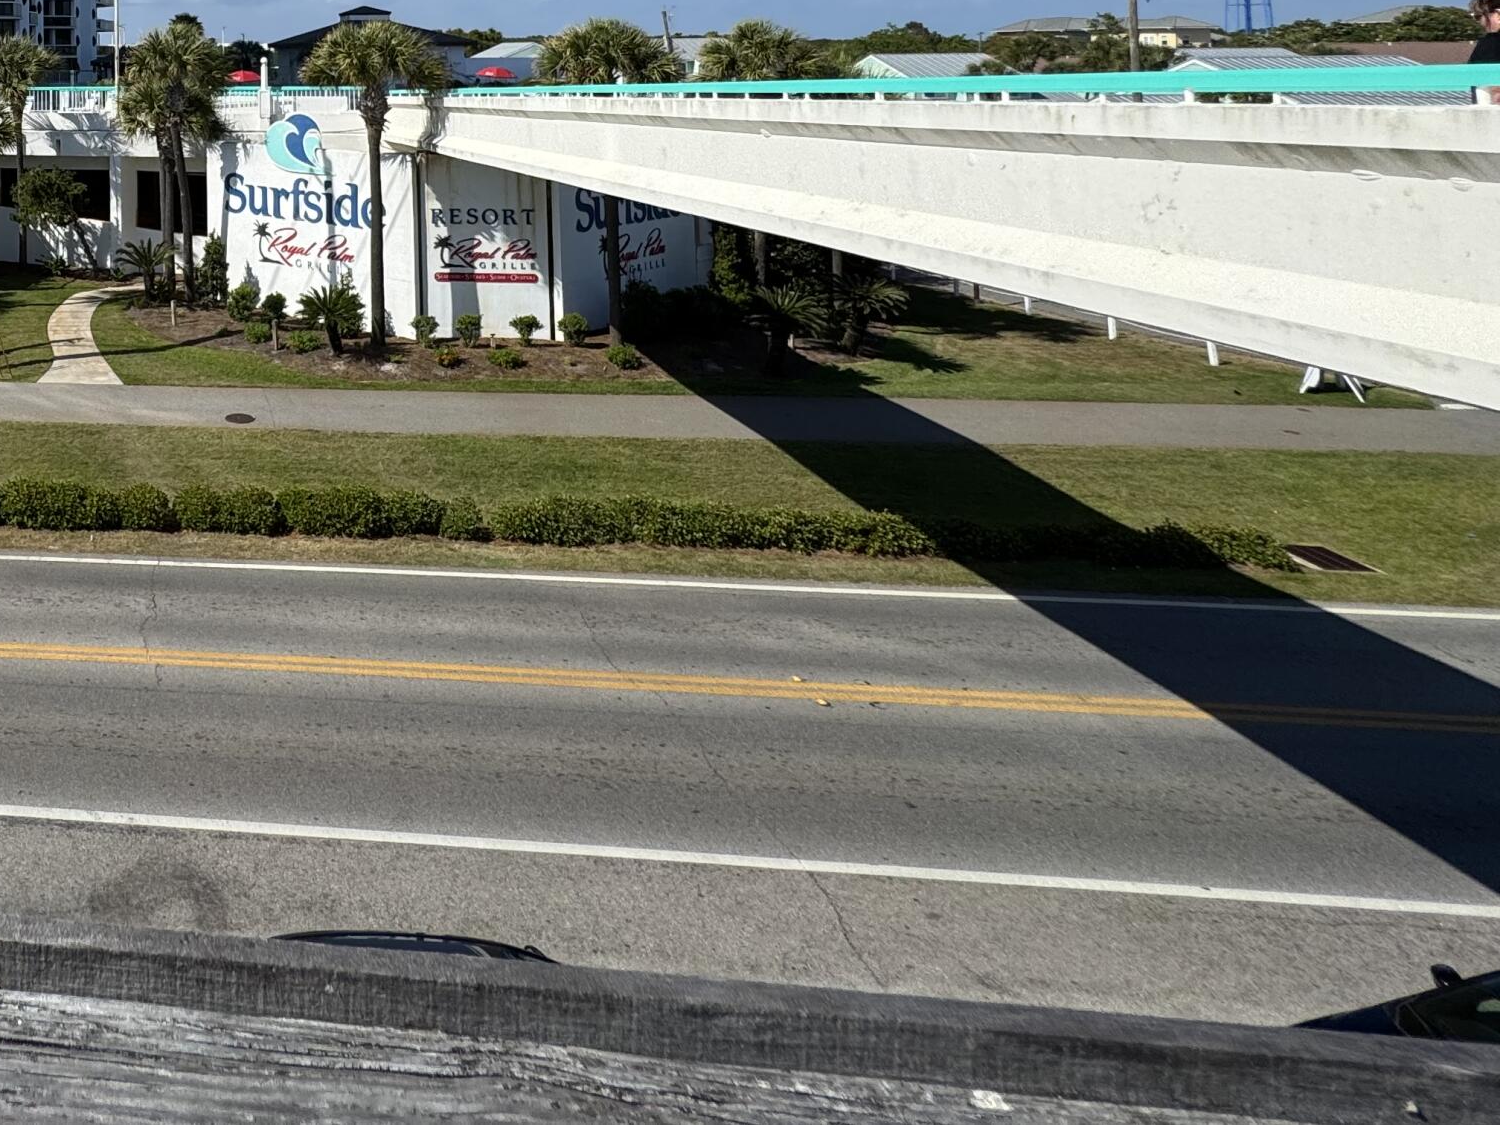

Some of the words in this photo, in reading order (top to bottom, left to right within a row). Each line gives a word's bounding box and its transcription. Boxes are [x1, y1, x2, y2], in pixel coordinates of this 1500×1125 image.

[431, 208, 535, 227] RESORT
[267, 228, 317, 267] Royal
[317, 234, 355, 263] Palm
[449, 237, 502, 269] Royal
[501, 238, 538, 260] Palm
[643, 227, 666, 258] Palm
[478, 262, 537, 271] GRILLE
